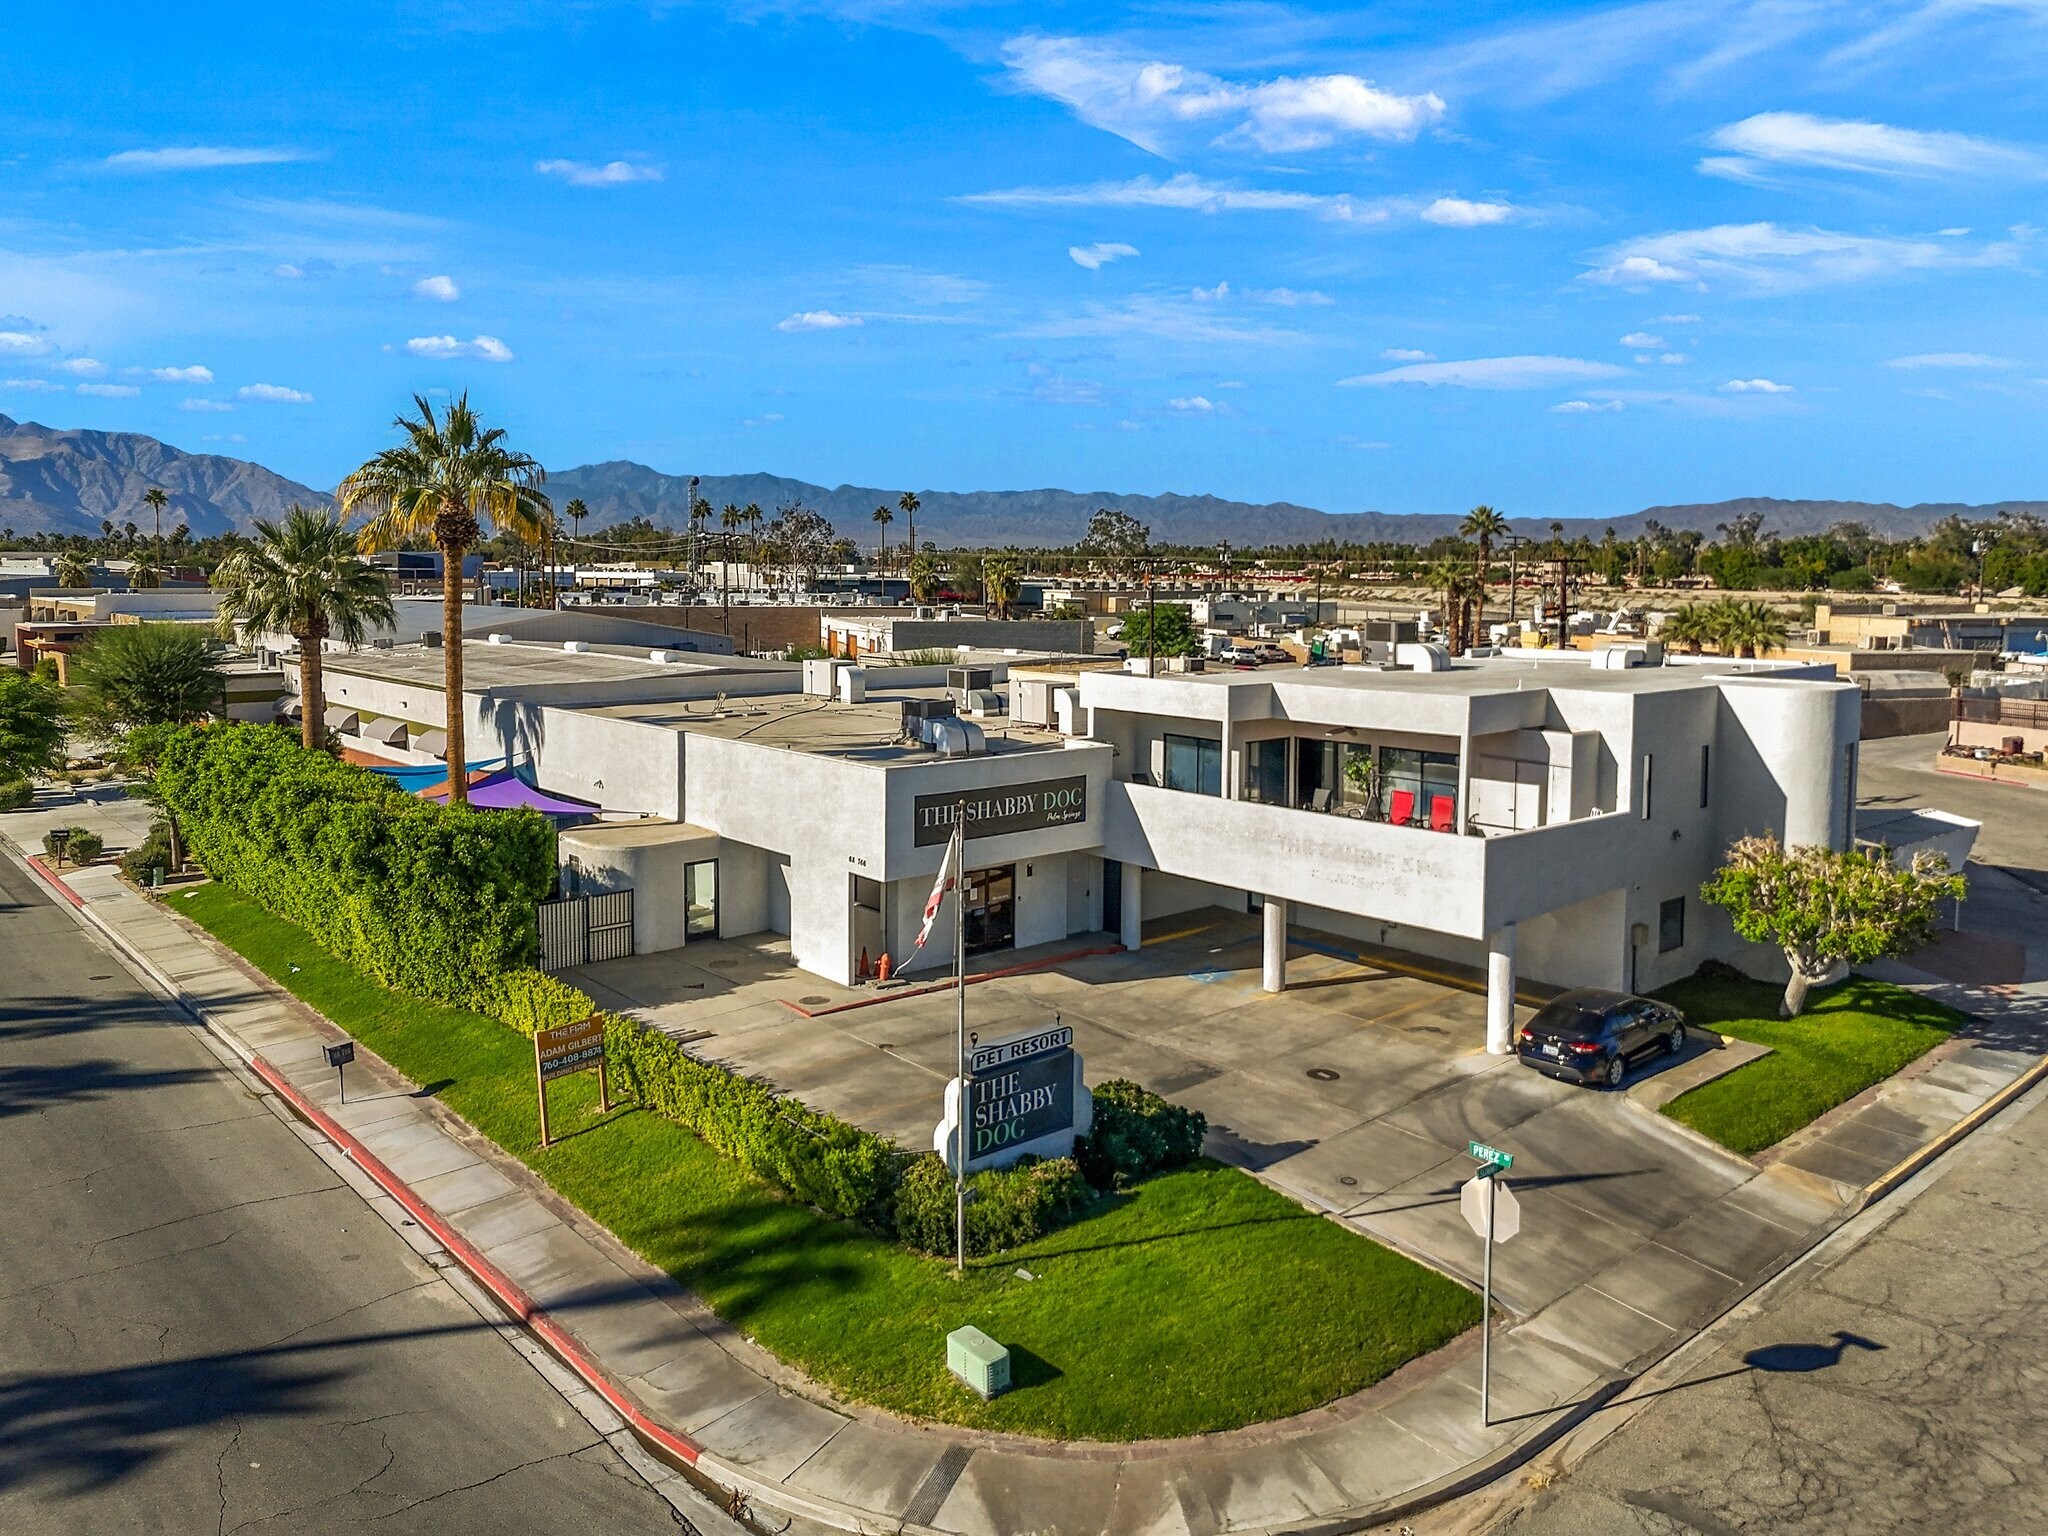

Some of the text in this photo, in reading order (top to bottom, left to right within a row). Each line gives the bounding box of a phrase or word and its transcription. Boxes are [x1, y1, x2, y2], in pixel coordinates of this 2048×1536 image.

[919, 788, 1082, 827] THE SHABBY DOG
[1046, 810, 1081, 822] Palm Springs
[551, 1022, 591, 1039] THE FIRM
[540, 1033, 602, 1059] ADAM GILBERT
[543, 1046, 602, 1071] 760-408-8874
[976, 1030, 1068, 1069] PET RESORT
[573, 1061, 588, 1072] FOR
[975, 1071, 1021, 1104] THE
[975, 1083, 1057, 1128] SHABBY
[976, 1117, 1025, 1152] DOG
[1473, 1145, 1500, 1164] PEREZ
